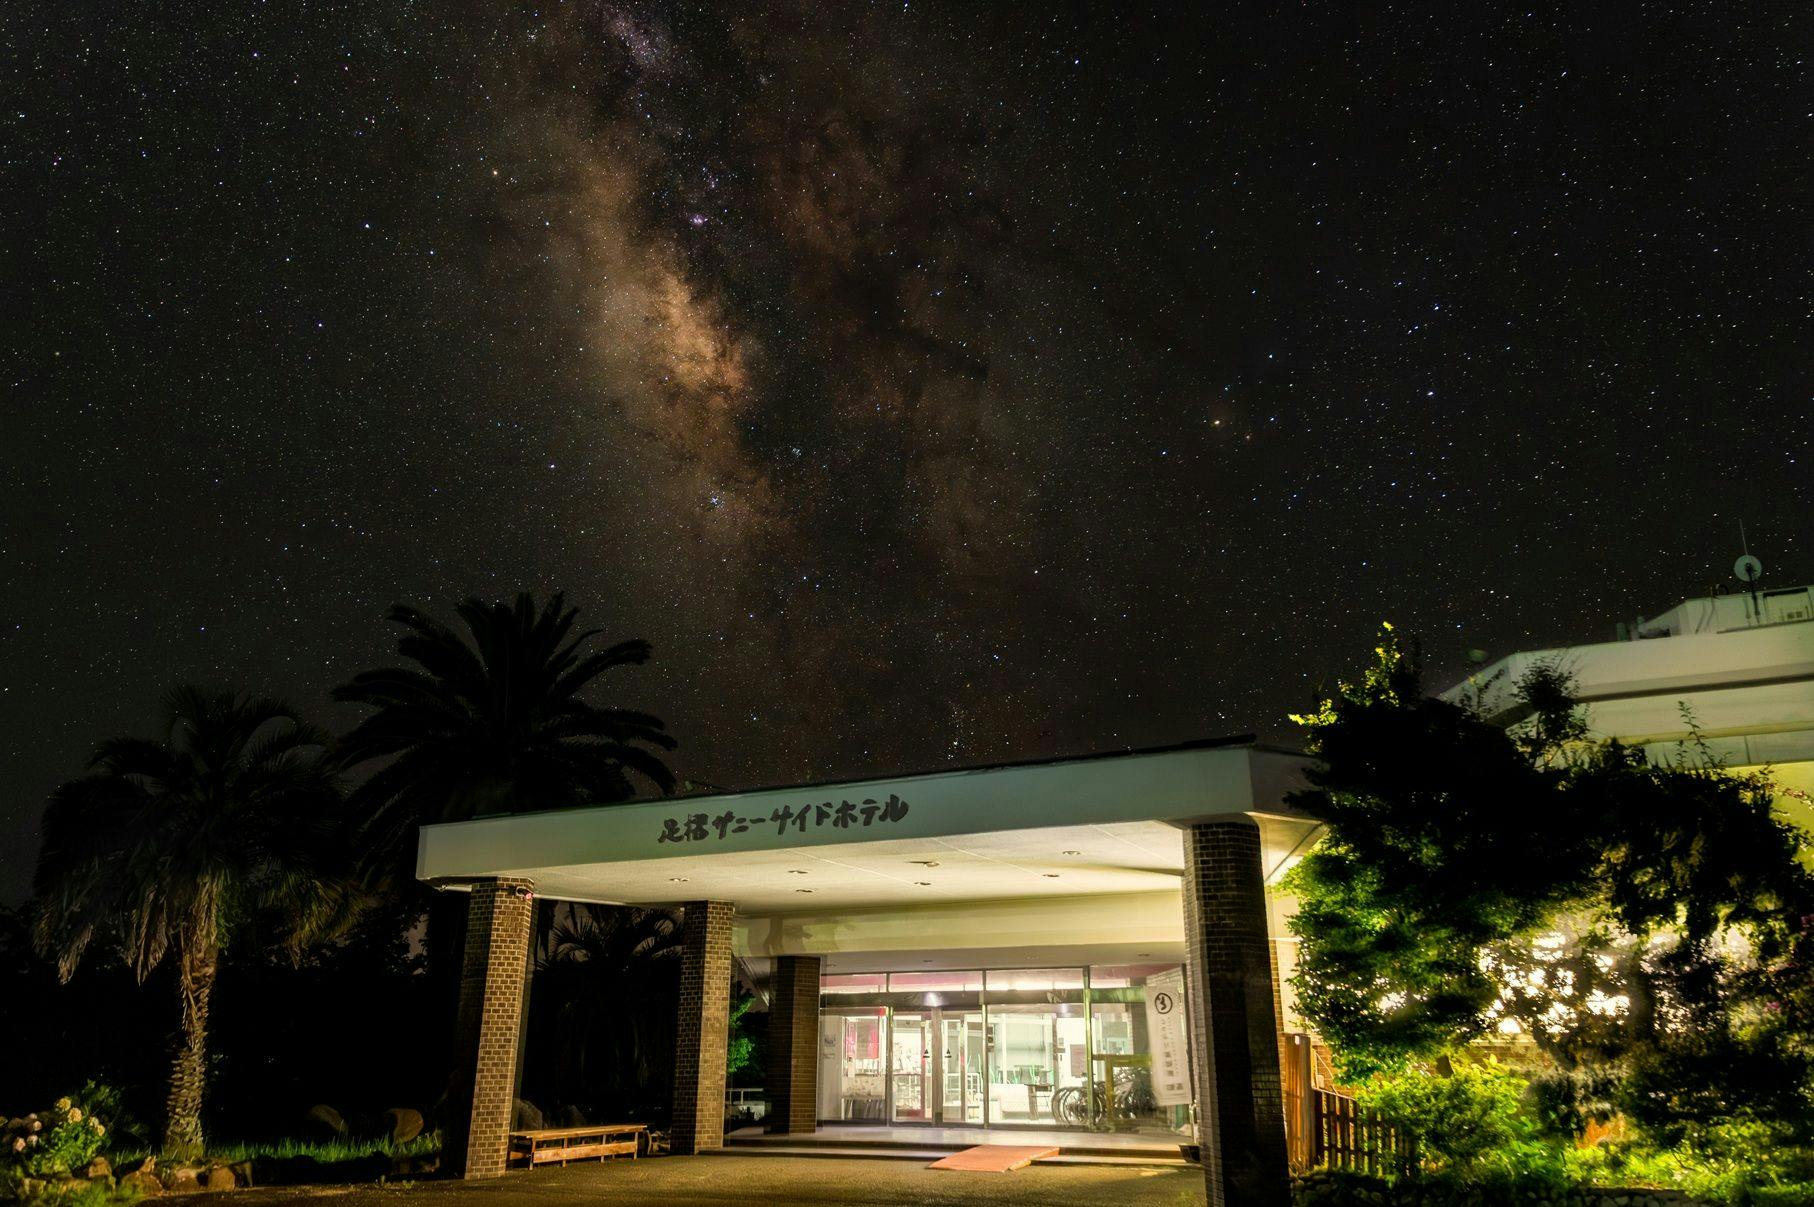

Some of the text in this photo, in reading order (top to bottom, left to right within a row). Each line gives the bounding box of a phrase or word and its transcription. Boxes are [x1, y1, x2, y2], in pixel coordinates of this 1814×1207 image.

[657, 794, 909, 843] 足摺サニーサイドホテル
